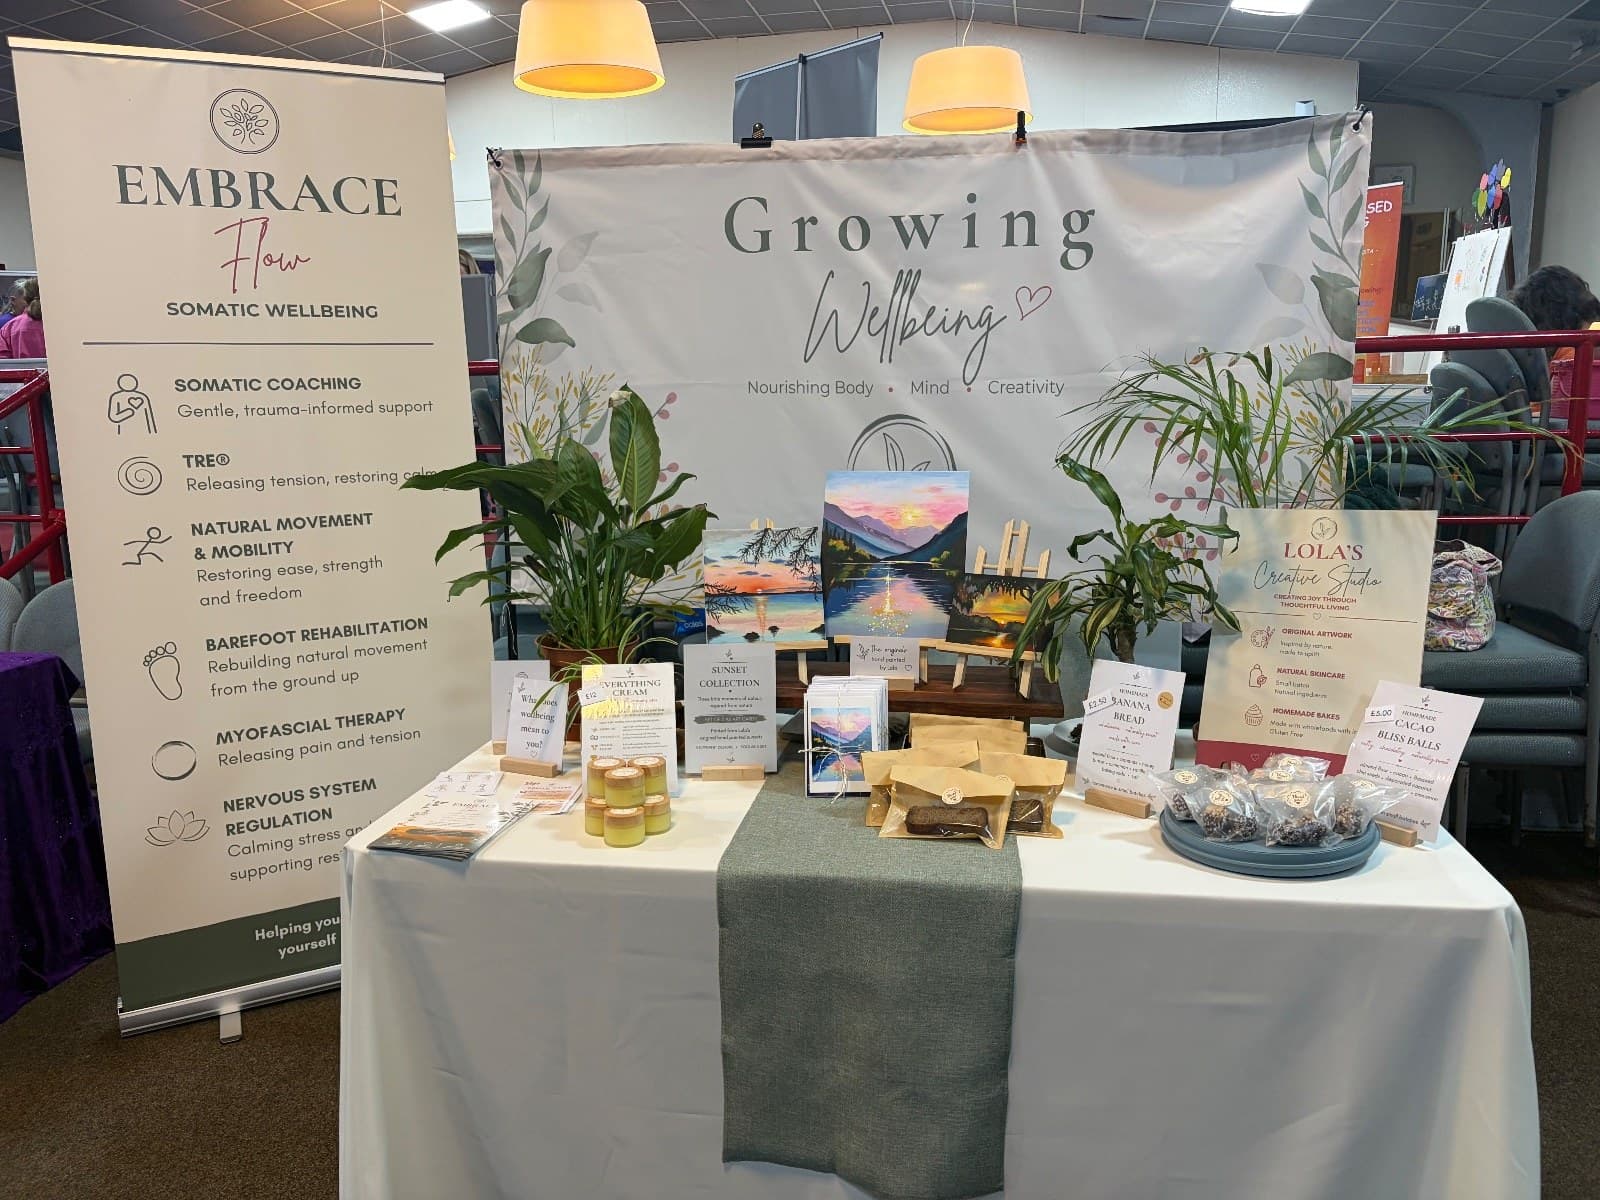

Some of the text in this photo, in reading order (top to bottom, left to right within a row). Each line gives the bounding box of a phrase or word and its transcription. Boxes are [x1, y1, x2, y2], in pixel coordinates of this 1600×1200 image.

[112, 164, 402, 217] EMBRACE
[1366, 200, 1393, 214] SED
[724, 192, 1096, 271] Growing
[214, 216, 312, 294] Flow
[166, 302, 379, 319] SOMATIC WELLBEING
[804, 268, 1007, 386] Wellbeing
[174, 377, 362, 393] SOMATIC COACHING
[747, 380, 1065, 398] Nourishing Body Mind Creativity
[177, 400, 433, 419] Gentle, trauma-informed support
[186, 475, 265, 492] Releasing
[269, 473, 330, 488] tension,
[334, 471, 398, 485] restoring
[190, 512, 373, 537] NATURAL MOVEMENT
[194, 541, 294, 560] & MOBILITY
[1284, 542, 1364, 561] LOLA'S
[196, 555, 383, 583] Restoring ease, strength
[1253, 560, 1382, 597] Creative Studio
[199, 586, 304, 607] and freedom
[1273, 593, 1307, 602] CREATING
[1322, 596, 1357, 604] THROUGH
[1280, 602, 1350, 611] THOUGHTFUL LIVING
[205, 617, 428, 652] BAREFOOT REHABILITATION
[1281, 628, 1353, 639] ORIGINAL ARTWORK
[207, 639, 428, 674] Rebuilding natural movement
[711, 665, 749, 675] SUNSET
[1276, 668, 1346, 679] NATURAL SKINCARE
[210, 670, 360, 697] from the ground up
[600, 680, 661, 688] EVERYTHING
[612, 688, 648, 697] CREAM
[699, 679, 761, 688] COLLECTION
[521, 694, 538, 704] Wha
[1111, 696, 1152, 712] BANANA
[1113, 711, 1145, 725] BREAD
[1272, 707, 1341, 721] HOMEMADE BAKES
[1370, 709, 1393, 717] £5.00
[1401, 710, 1437, 722] HOMEMADE
[215, 707, 406, 745] MYOFASCIAL THERAPY
[520, 726, 540, 734] mean
[1394, 720, 1435, 734] CACAO
[218, 728, 421, 768] Releasing pain and tension
[526, 740, 543, 750] you?
[1377, 730, 1405, 743] BLISS
[1407, 736, 1442, 751] BALLS
[223, 778, 377, 813] NERVOUS SYSTEM
[225, 807, 333, 837] REGULATION
[227, 835, 294, 858] Calming
[298, 828, 341, 847] stress
[229, 850, 343, 882] supporting res
[255, 920, 312, 943] Helping
[278, 932, 337, 960] yourself
